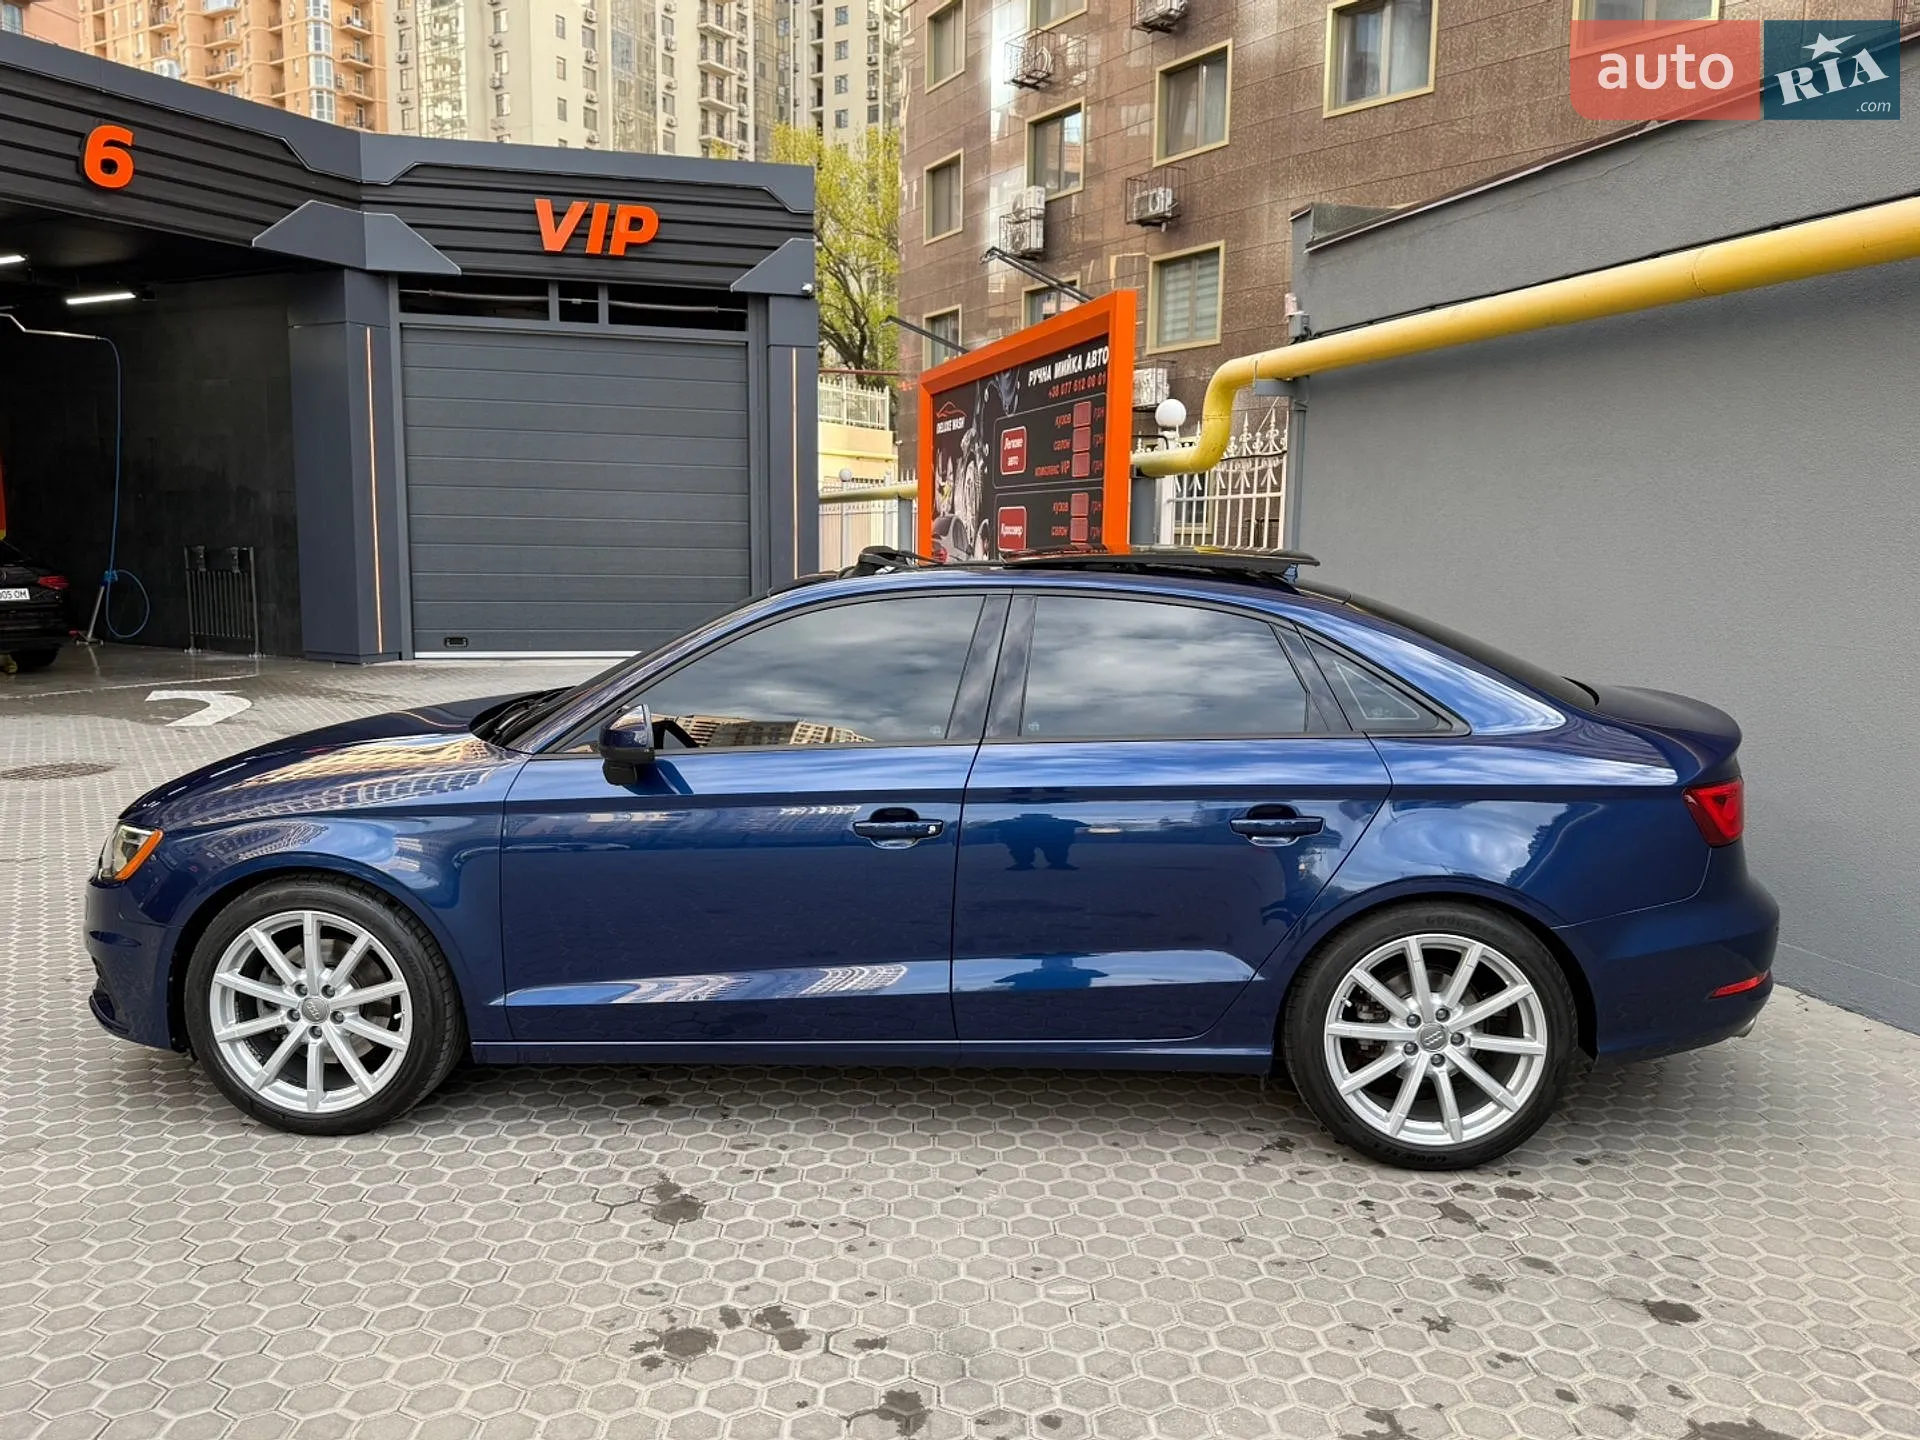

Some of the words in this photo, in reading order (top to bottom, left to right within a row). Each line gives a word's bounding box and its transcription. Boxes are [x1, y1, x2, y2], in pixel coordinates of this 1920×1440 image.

[82, 125, 135, 190] 6
[534, 198, 660, 256] VIP
[1027, 364, 1052, 387] РУЧНА
[1053, 353, 1083, 379] МИЙКА
[1084, 345, 1110, 370] АВТО
